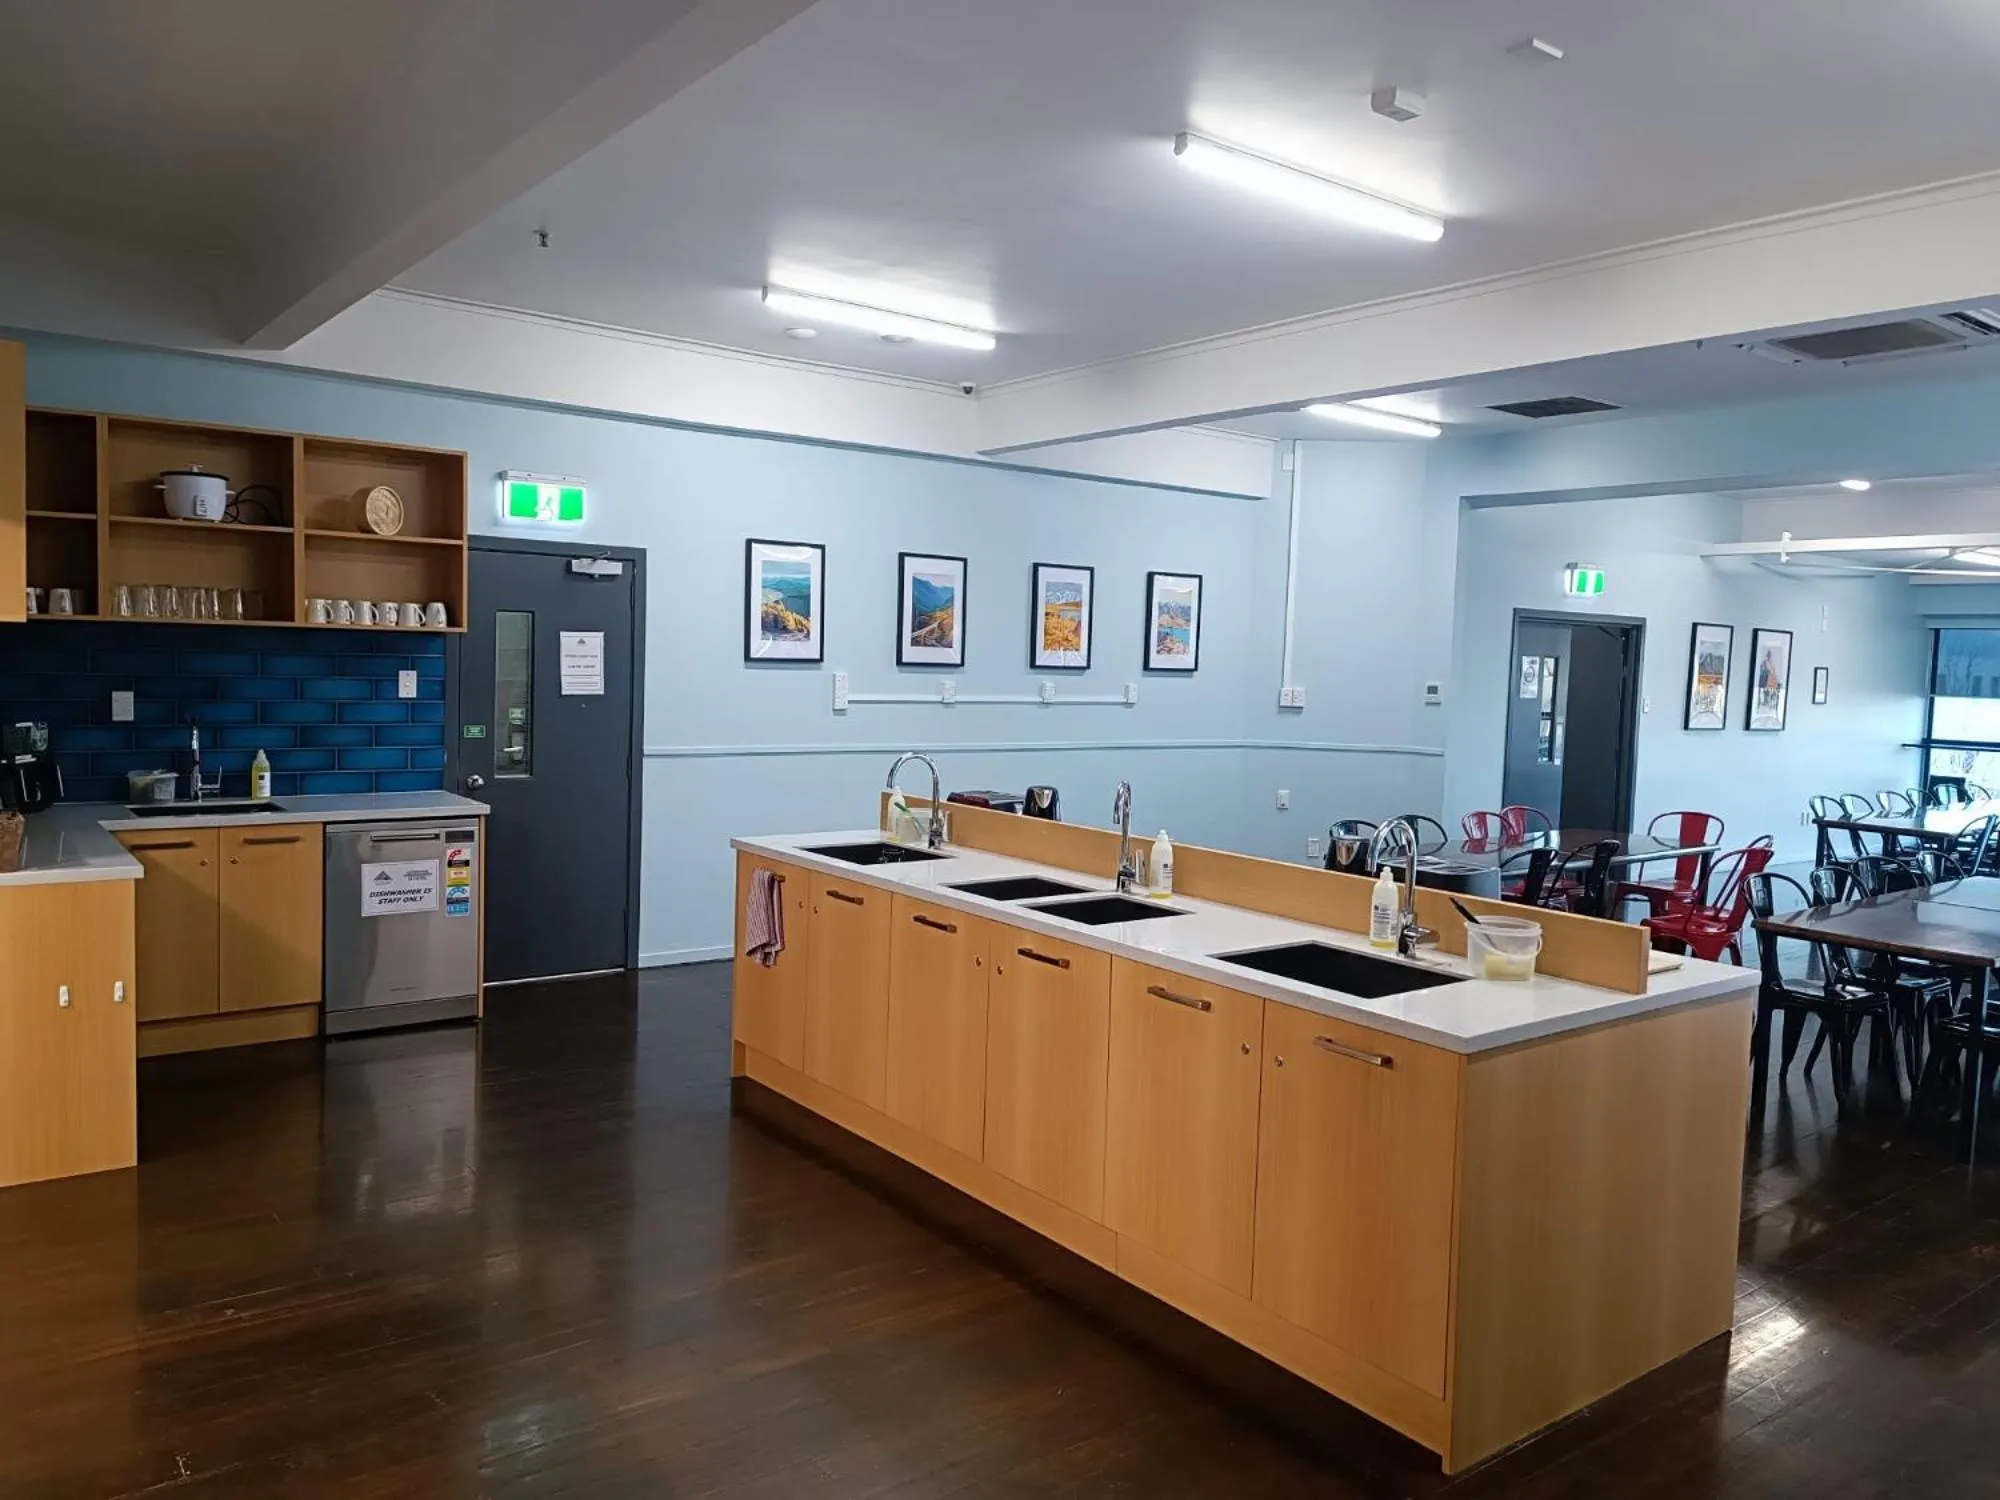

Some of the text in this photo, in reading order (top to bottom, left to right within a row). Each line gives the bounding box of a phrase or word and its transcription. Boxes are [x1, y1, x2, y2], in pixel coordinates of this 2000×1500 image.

[369, 889, 422, 898] DISHWASHER
[378, 895, 424, 905] STAFF ONLY
